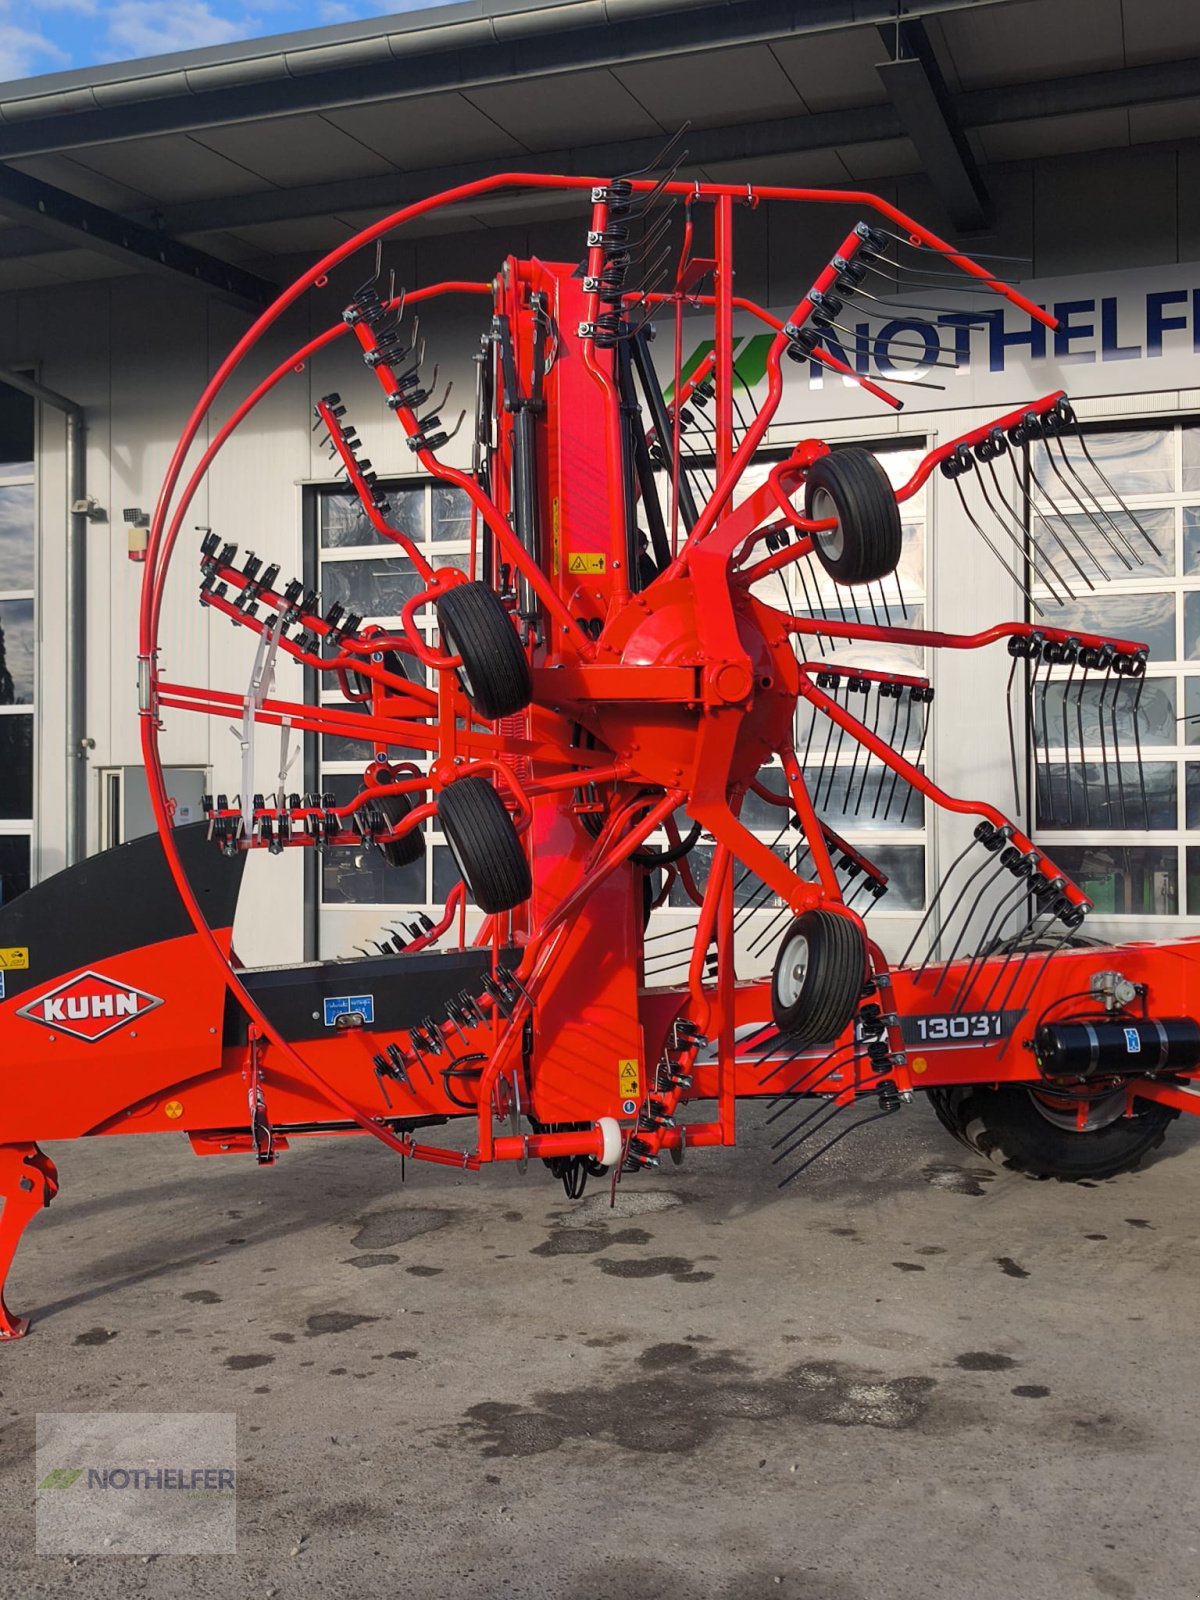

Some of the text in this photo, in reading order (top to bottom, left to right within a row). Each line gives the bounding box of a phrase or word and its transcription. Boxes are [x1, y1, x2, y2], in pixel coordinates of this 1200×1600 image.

[808, 289, 1200, 390] NOTHELF
[43, 992, 138, 1021] KUHN
[917, 1015, 1001, 1040] 13031
